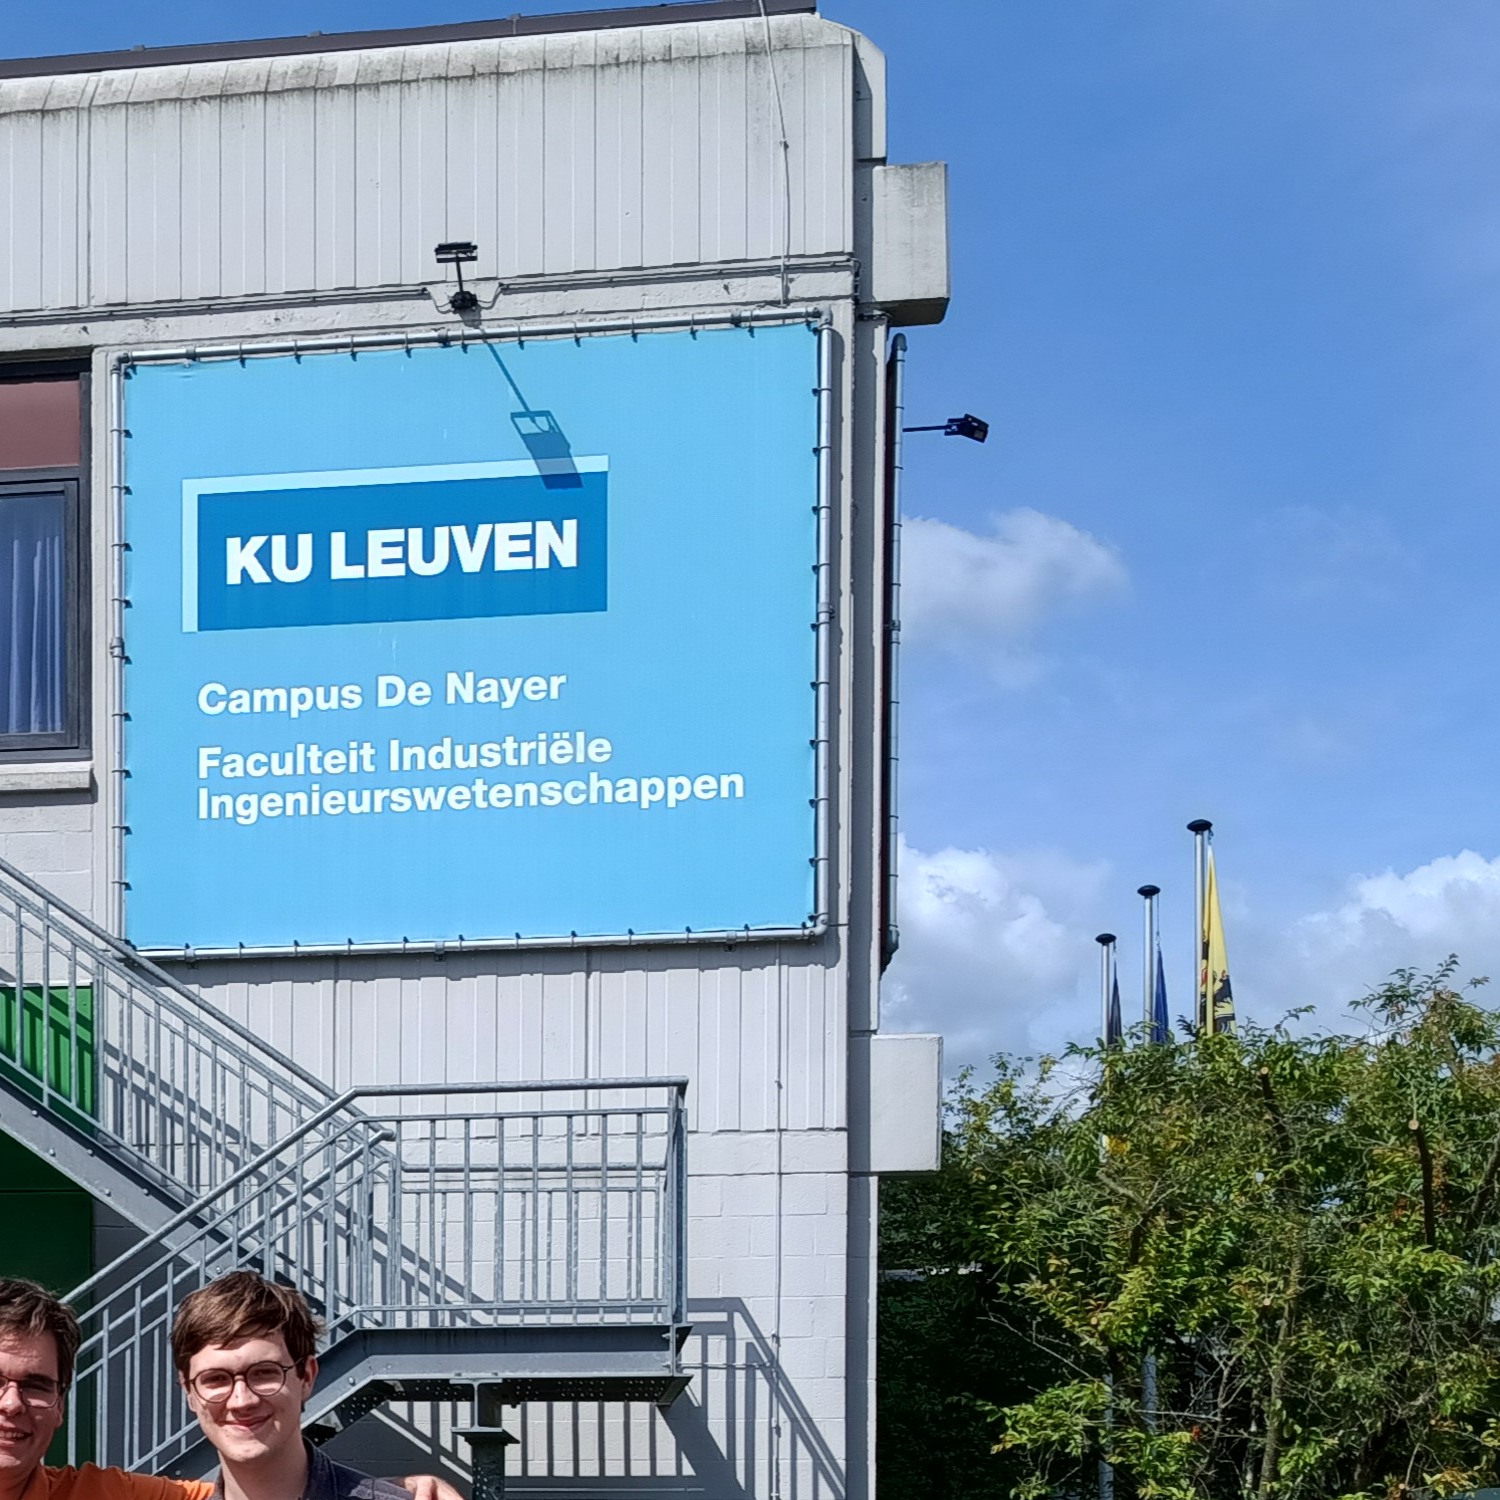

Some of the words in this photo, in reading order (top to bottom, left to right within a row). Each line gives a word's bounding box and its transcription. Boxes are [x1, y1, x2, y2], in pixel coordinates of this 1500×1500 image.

[226, 533, 313, 585] KU
[330, 518, 578, 580] LEUVEN
[198, 682, 362, 718] Campus
[378, 674, 431, 707] De
[446, 671, 567, 709] Nayer
[198, 741, 375, 779] Faculteit
[389, 730, 612, 771] Industriële
[198, 771, 744, 825] Ingenieurswetenschappen
